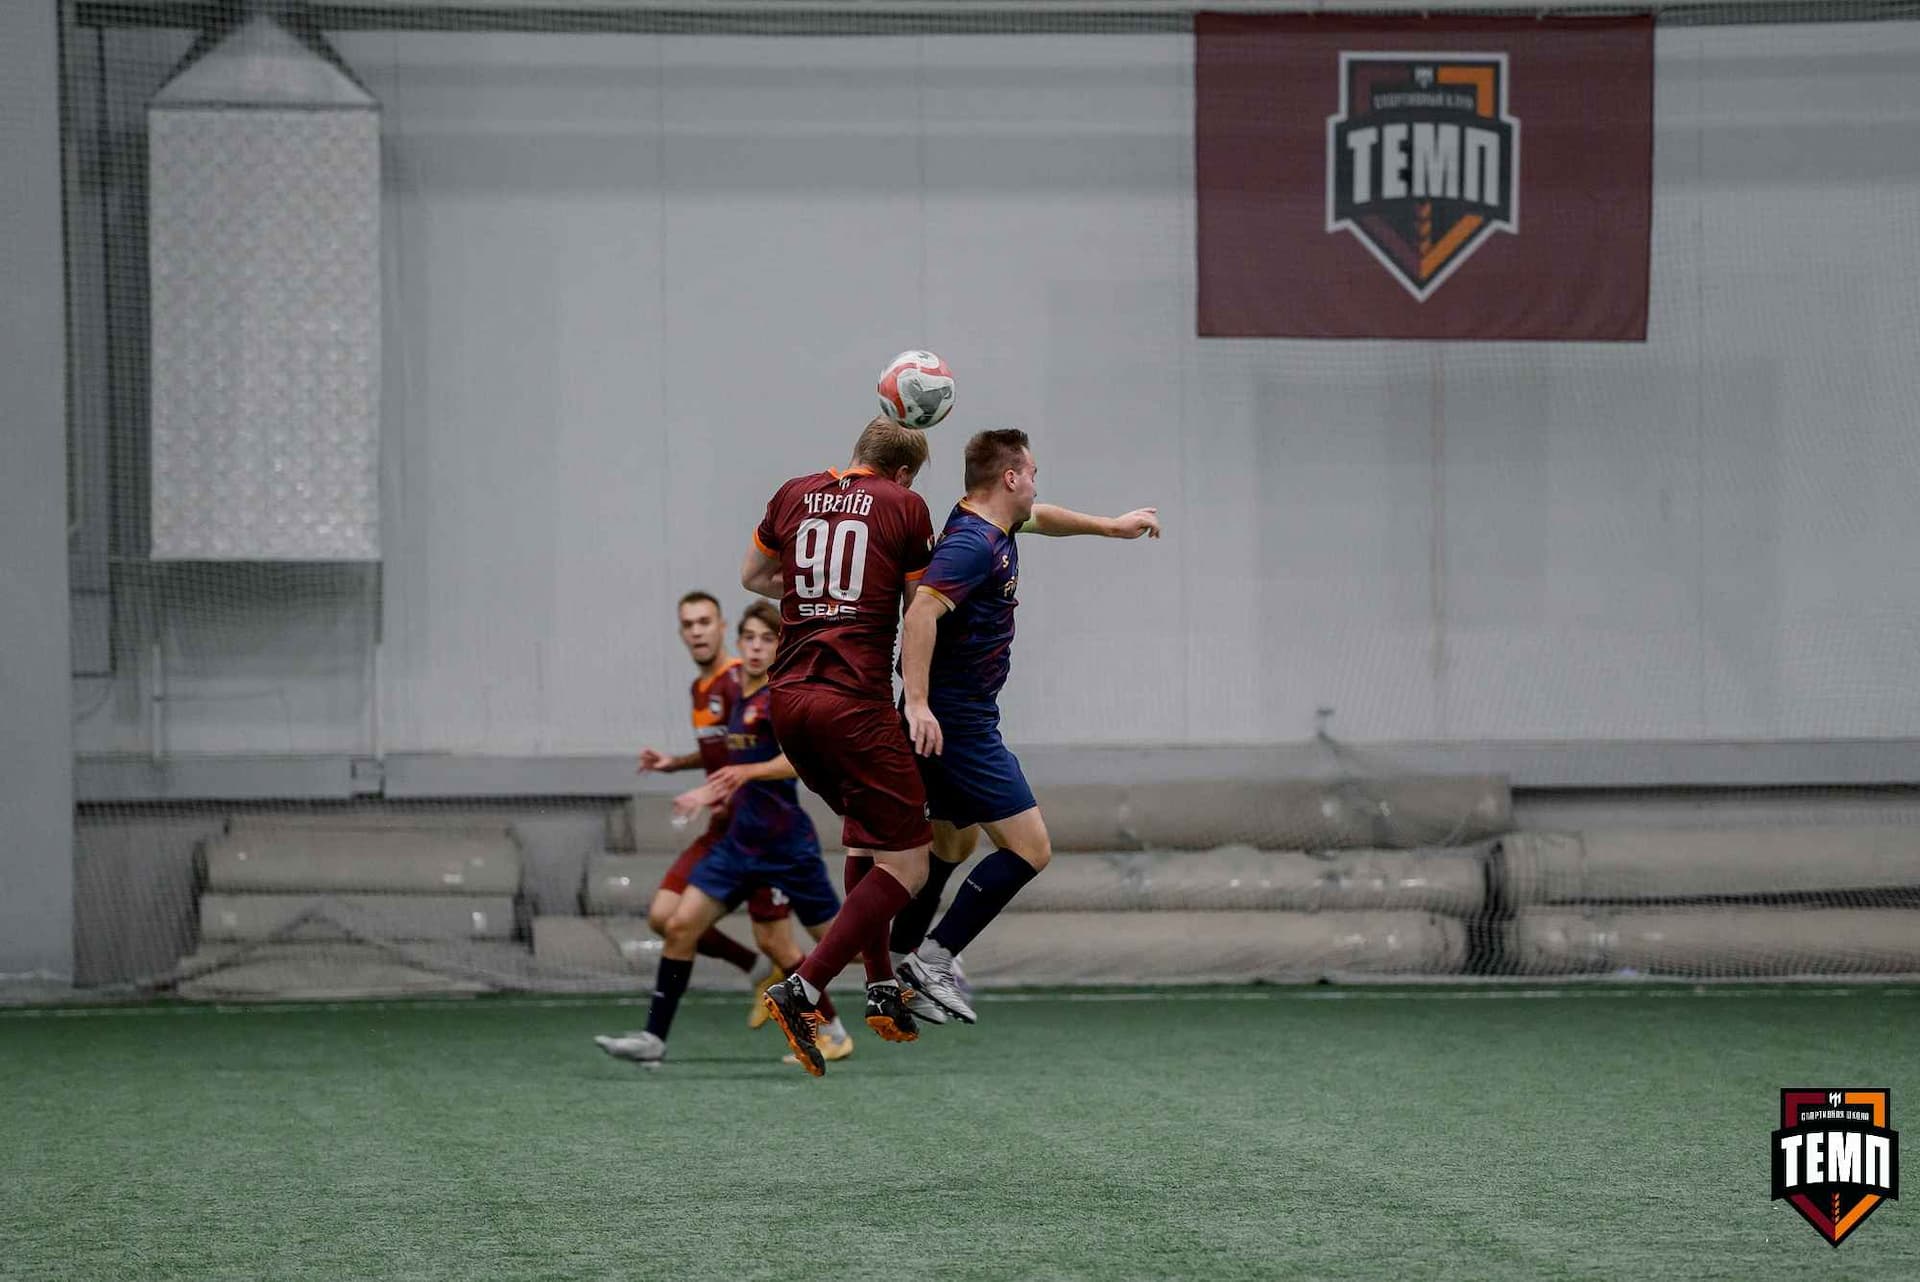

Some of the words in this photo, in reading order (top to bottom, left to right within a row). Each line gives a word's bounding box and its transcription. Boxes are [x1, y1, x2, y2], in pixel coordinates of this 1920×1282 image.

[1347, 122, 1500, 206] ТЕМП
[803, 489, 874, 516] ЧЕВЕЛЁВ
[795, 517, 869, 601] 90
